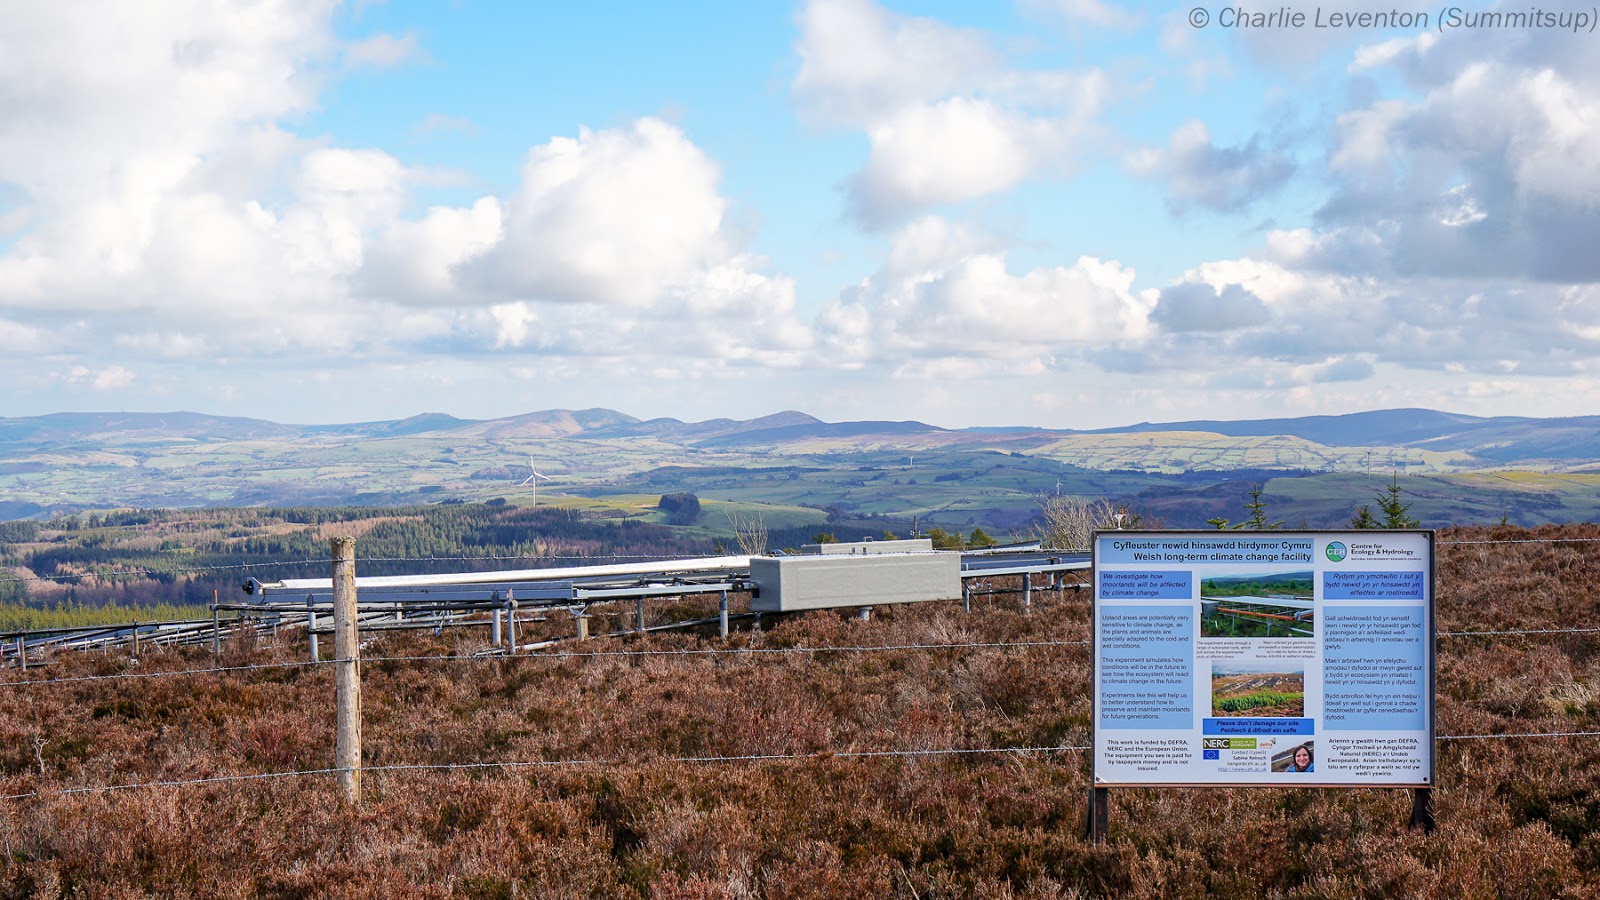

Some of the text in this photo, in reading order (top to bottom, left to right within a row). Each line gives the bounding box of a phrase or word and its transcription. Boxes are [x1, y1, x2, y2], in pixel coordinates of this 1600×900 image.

[1113, 541, 1160, 551] Cyfleuster
[1237, 541, 1279, 551] hirdymor
[1280, 541, 1311, 551] Cymru
[1164, 553, 1208, 562] long-term
[1245, 553, 1279, 562] change
[1280, 553, 1311, 562] facility
[1204, 739, 1229, 748] NERC
